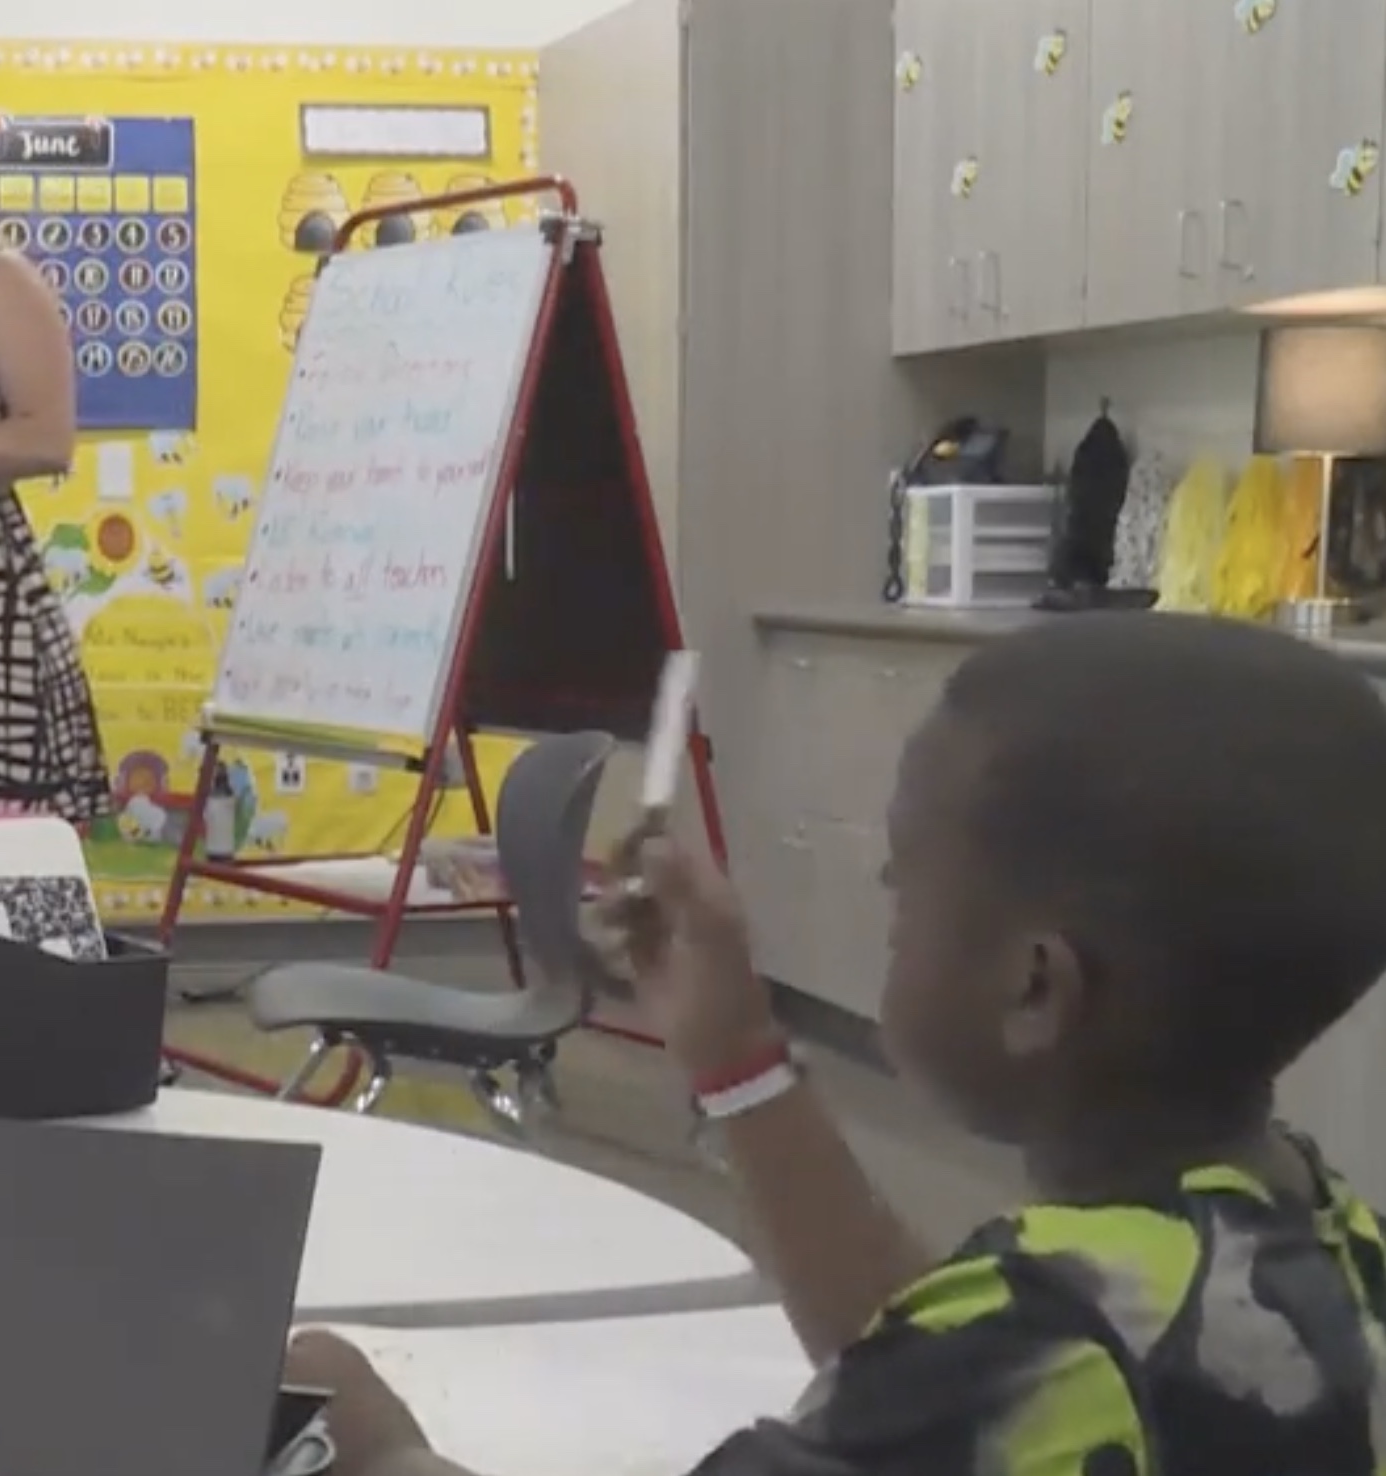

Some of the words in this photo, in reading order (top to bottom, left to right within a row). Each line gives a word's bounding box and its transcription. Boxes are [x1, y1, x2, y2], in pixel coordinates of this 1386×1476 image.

[19, 129, 81, 160] June
[48, 223, 64, 246] 2
[91, 222, 104, 247] 3
[125, 222, 139, 246] 4
[166, 223, 182, 249] 5
